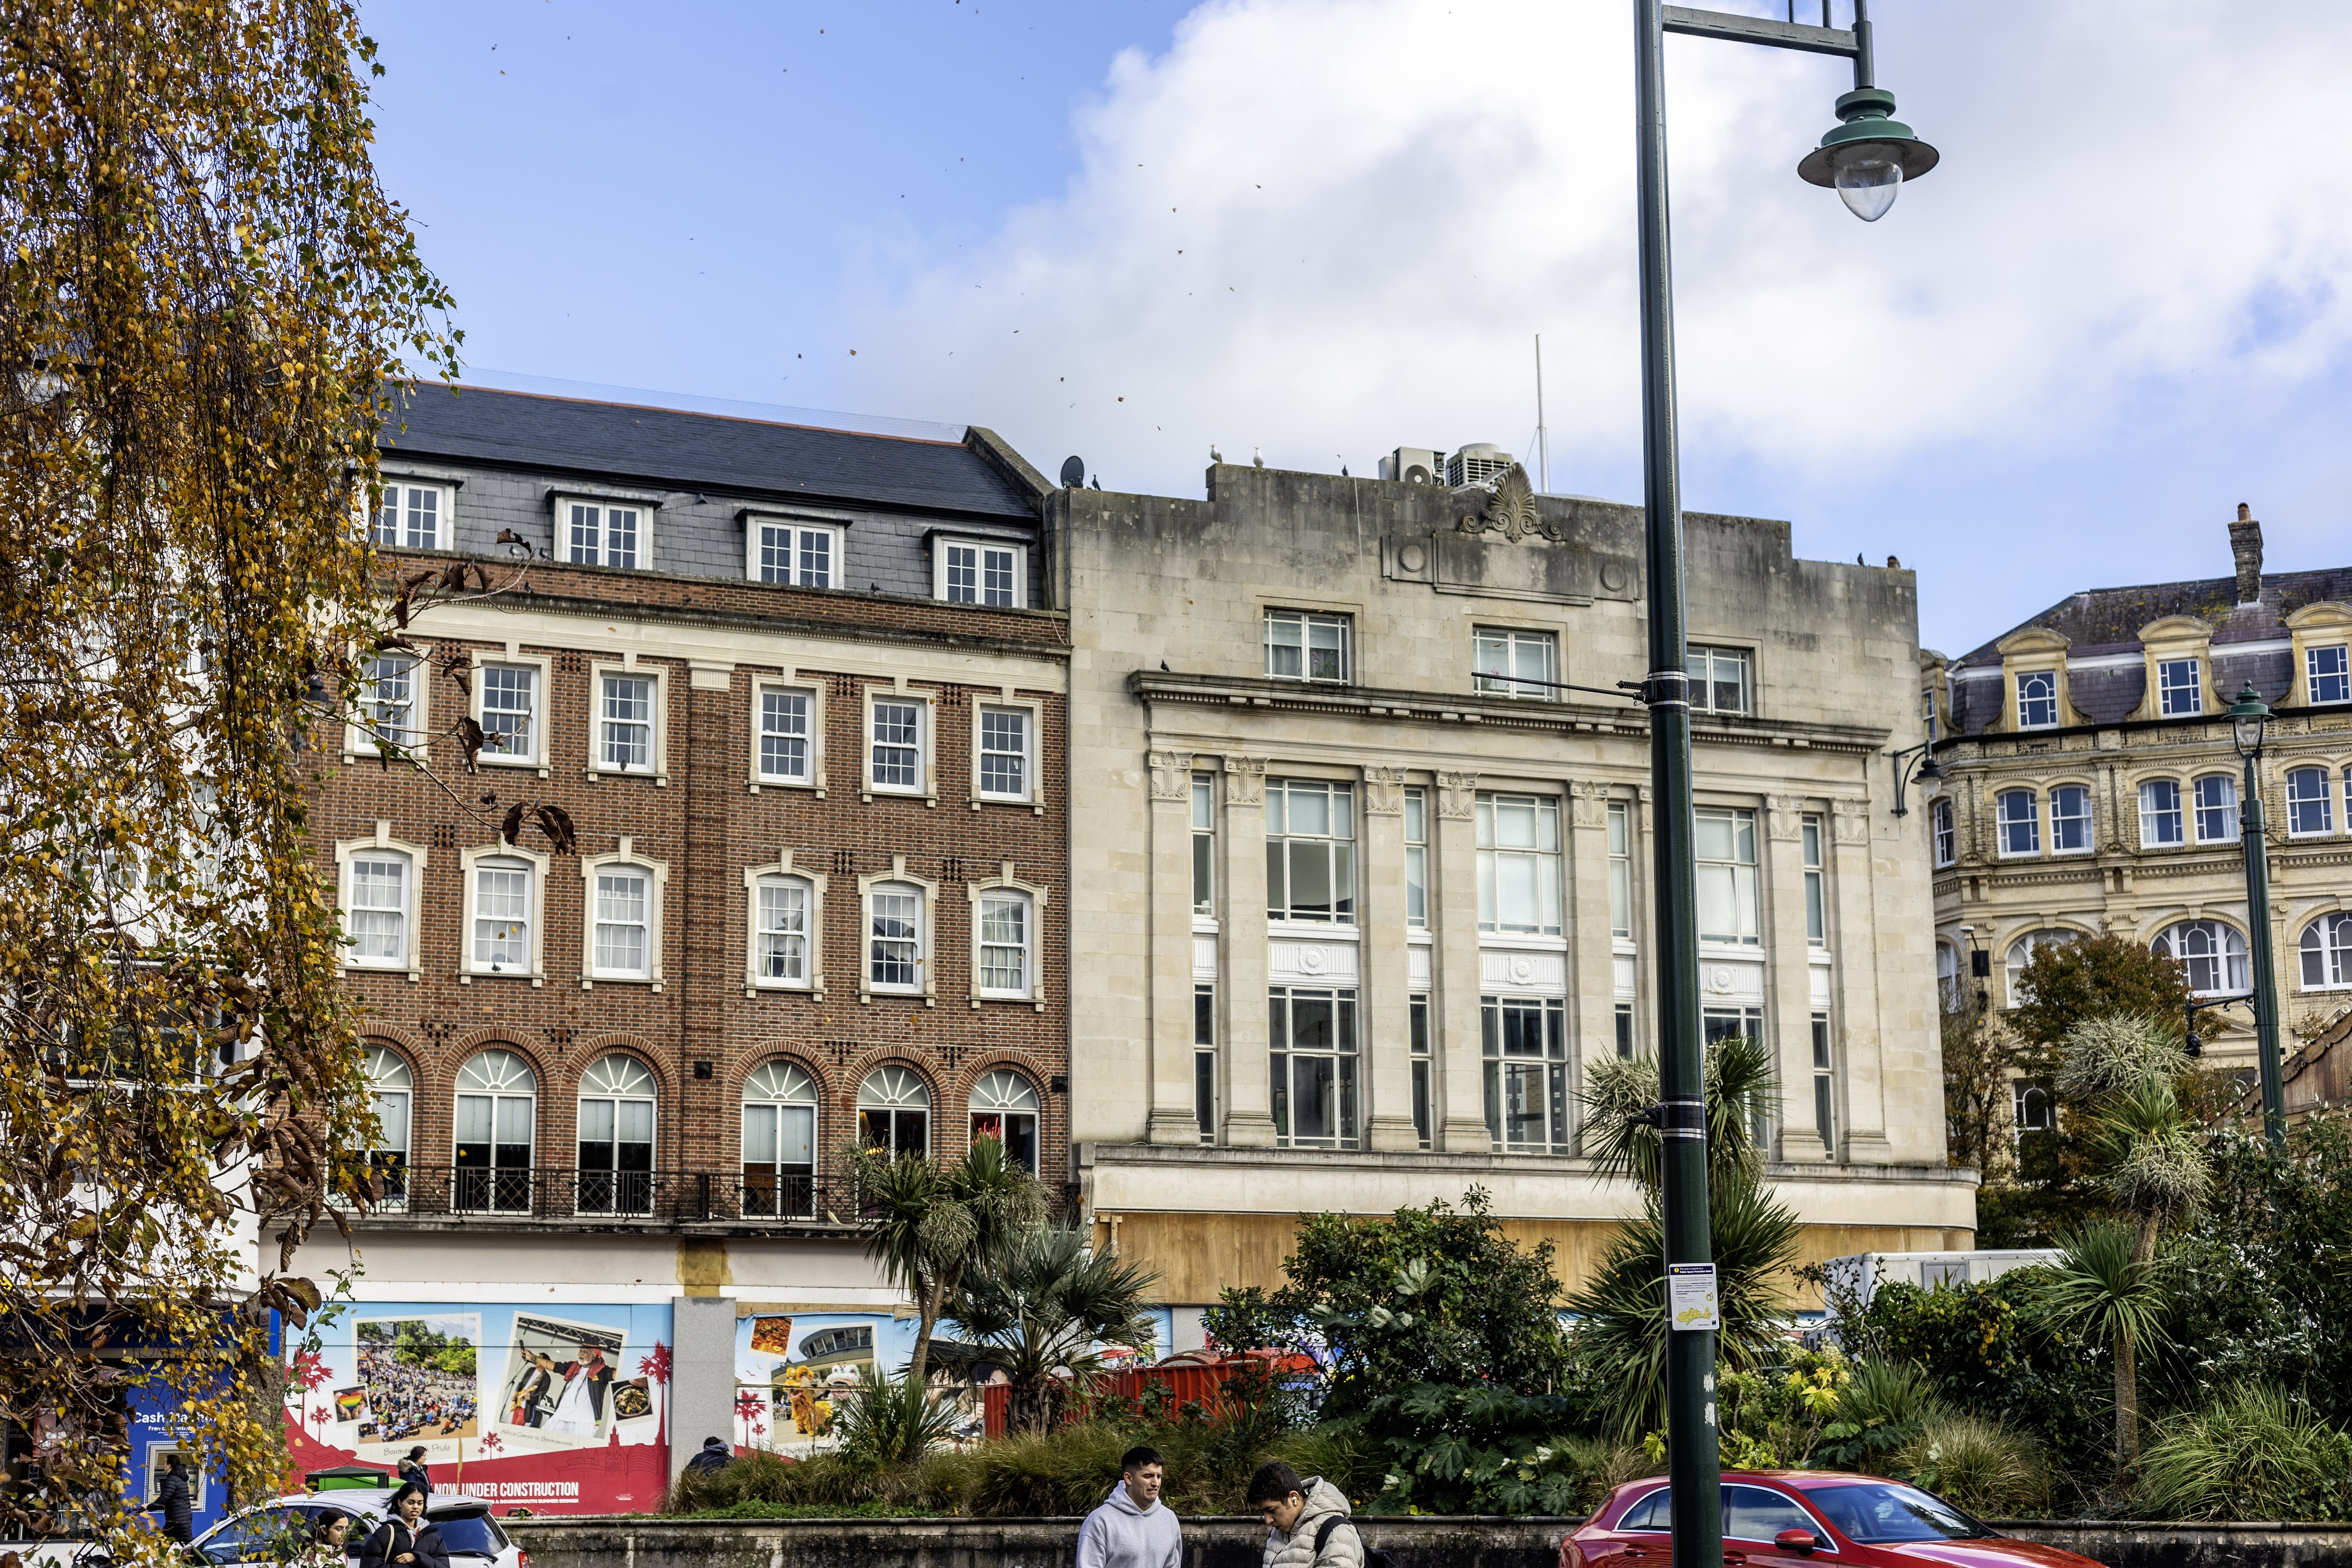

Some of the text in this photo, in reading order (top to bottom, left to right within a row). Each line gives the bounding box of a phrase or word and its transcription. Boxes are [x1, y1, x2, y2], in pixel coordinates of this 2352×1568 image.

[136, 1412, 165, 1423] Cash
[517, 1432, 533, 1440] Comes
[541, 1436, 573, 1447] Bournemouth
[432, 1444, 450, 1452] Pride
[434, 1482, 579, 1497] NOW UNDER CONSTRUCTION
